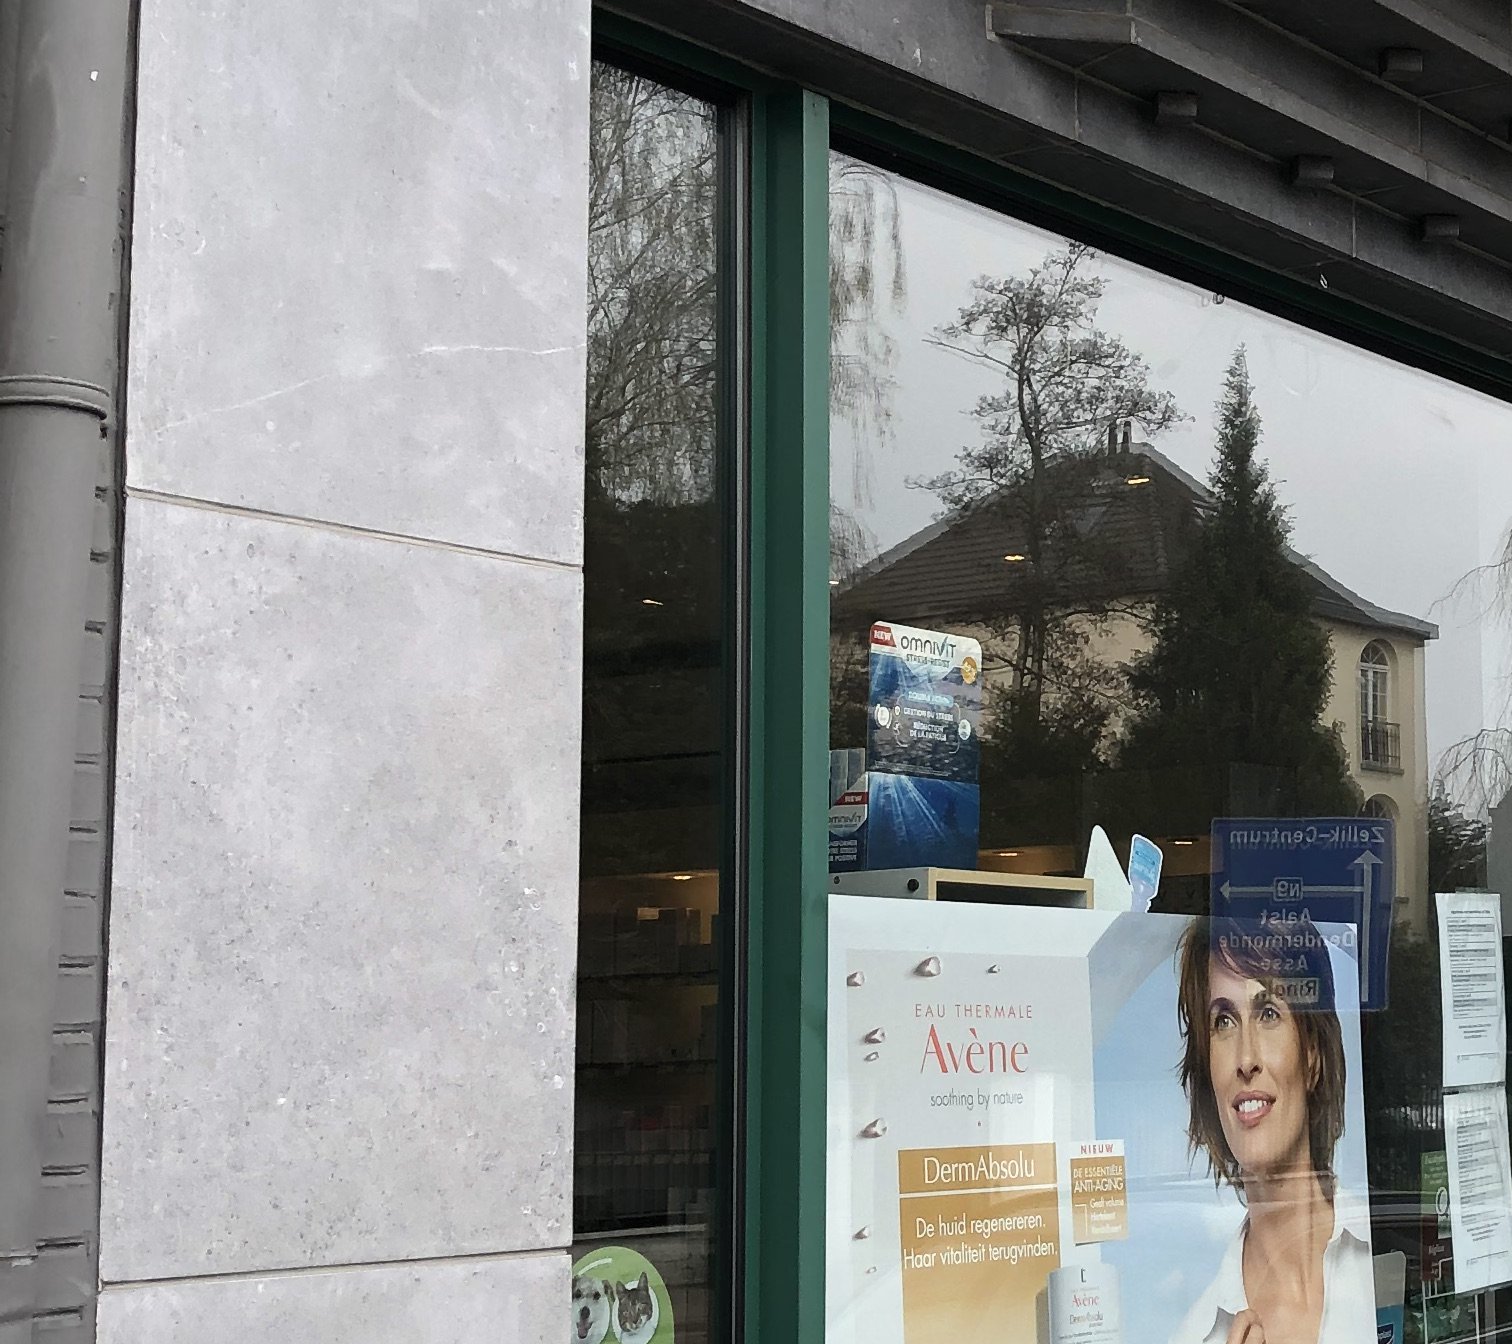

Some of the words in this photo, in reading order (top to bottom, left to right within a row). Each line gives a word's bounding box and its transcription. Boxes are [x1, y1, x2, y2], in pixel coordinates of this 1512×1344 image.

[915, 1003, 946, 1018] EAU
[955, 1004, 1033, 1019] THERMALE
[920, 1023, 1029, 1074] Avène
[930, 1088, 974, 1111] soothing
[977, 1088, 990, 1110] by
[993, 1091, 1023, 1105] nature
[1080, 1144, 1114, 1154] NIEUW
[924, 1150, 1035, 1184] DermAbsolu
[1073, 1168, 1083, 1178] DE
[1073, 1177, 1124, 1194] ANTI-AGING
[916, 1217, 935, 1238] De
[938, 1212, 967, 1237] huid
[970, 1214, 1046, 1238] regenereren.
[903, 1248, 937, 1269] Haar
[940, 1242, 986, 1265] vitaliteit
[988, 1235, 1058, 1265] terugvinden.
